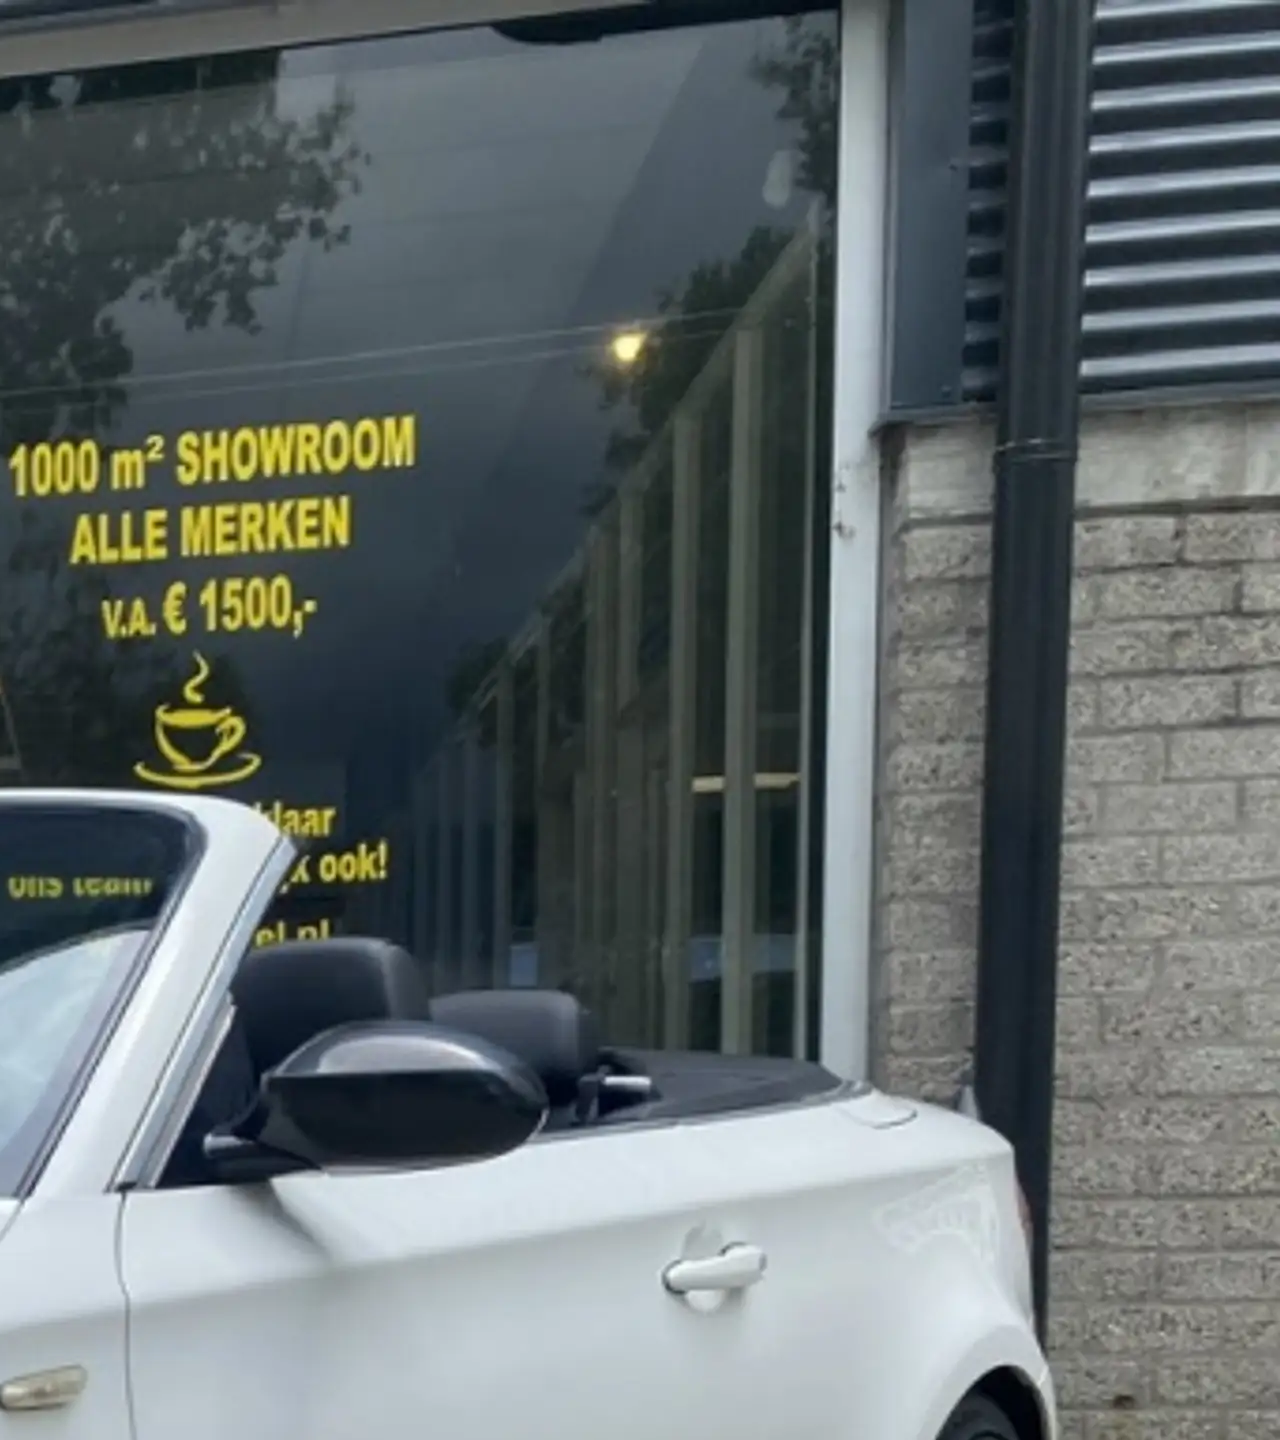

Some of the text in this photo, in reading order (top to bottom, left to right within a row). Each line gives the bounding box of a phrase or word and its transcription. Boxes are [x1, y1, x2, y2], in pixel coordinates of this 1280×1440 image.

[9, 439, 100, 496] 1000
[176, 414, 416, 485] SHOWROOM
[69, 496, 351, 564] ALLE MERKEN
[163, 581, 187, 634] €
[199, 574, 317, 638] 1500,-
[253, 800, 337, 837] laar
[319, 837, 388, 883] ook!
